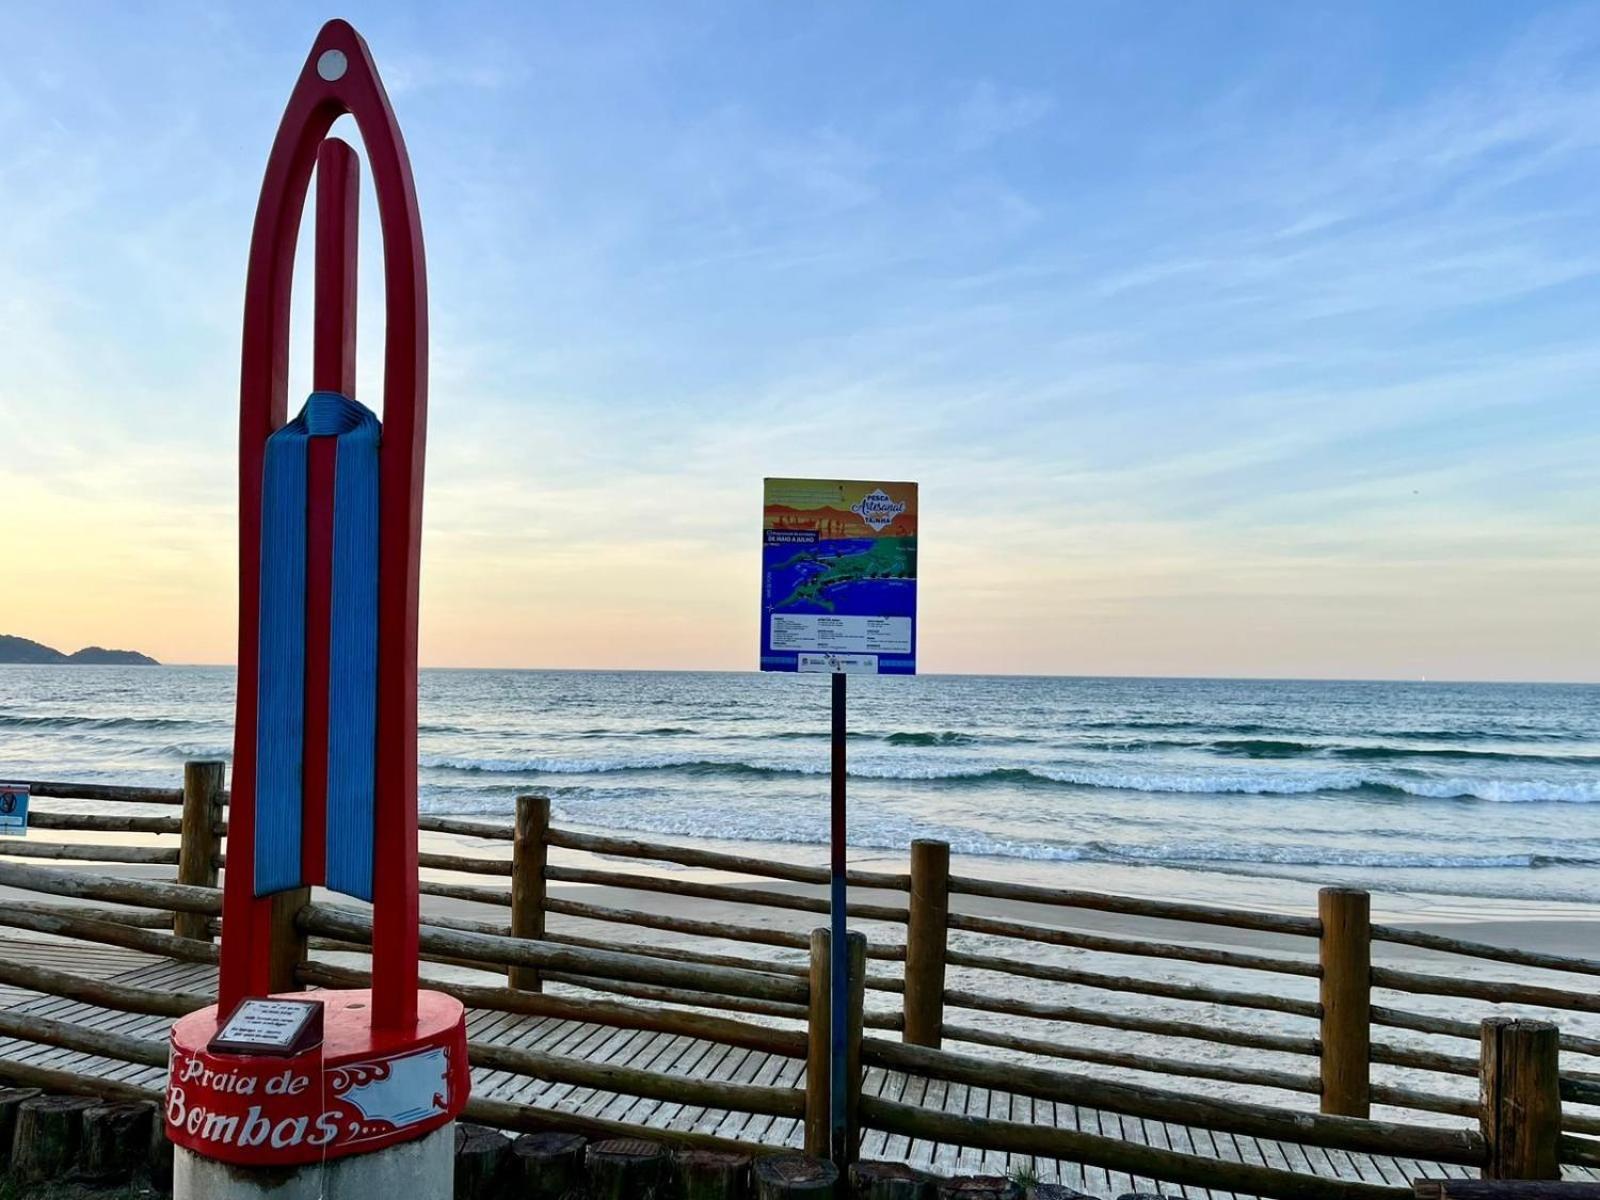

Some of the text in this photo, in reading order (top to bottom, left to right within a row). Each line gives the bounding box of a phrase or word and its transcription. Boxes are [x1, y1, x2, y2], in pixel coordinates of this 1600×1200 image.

[852, 498, 905, 515] Artesanal
[179, 1057, 309, 1095] Praia de
[168, 1086, 344, 1148] Bombas
